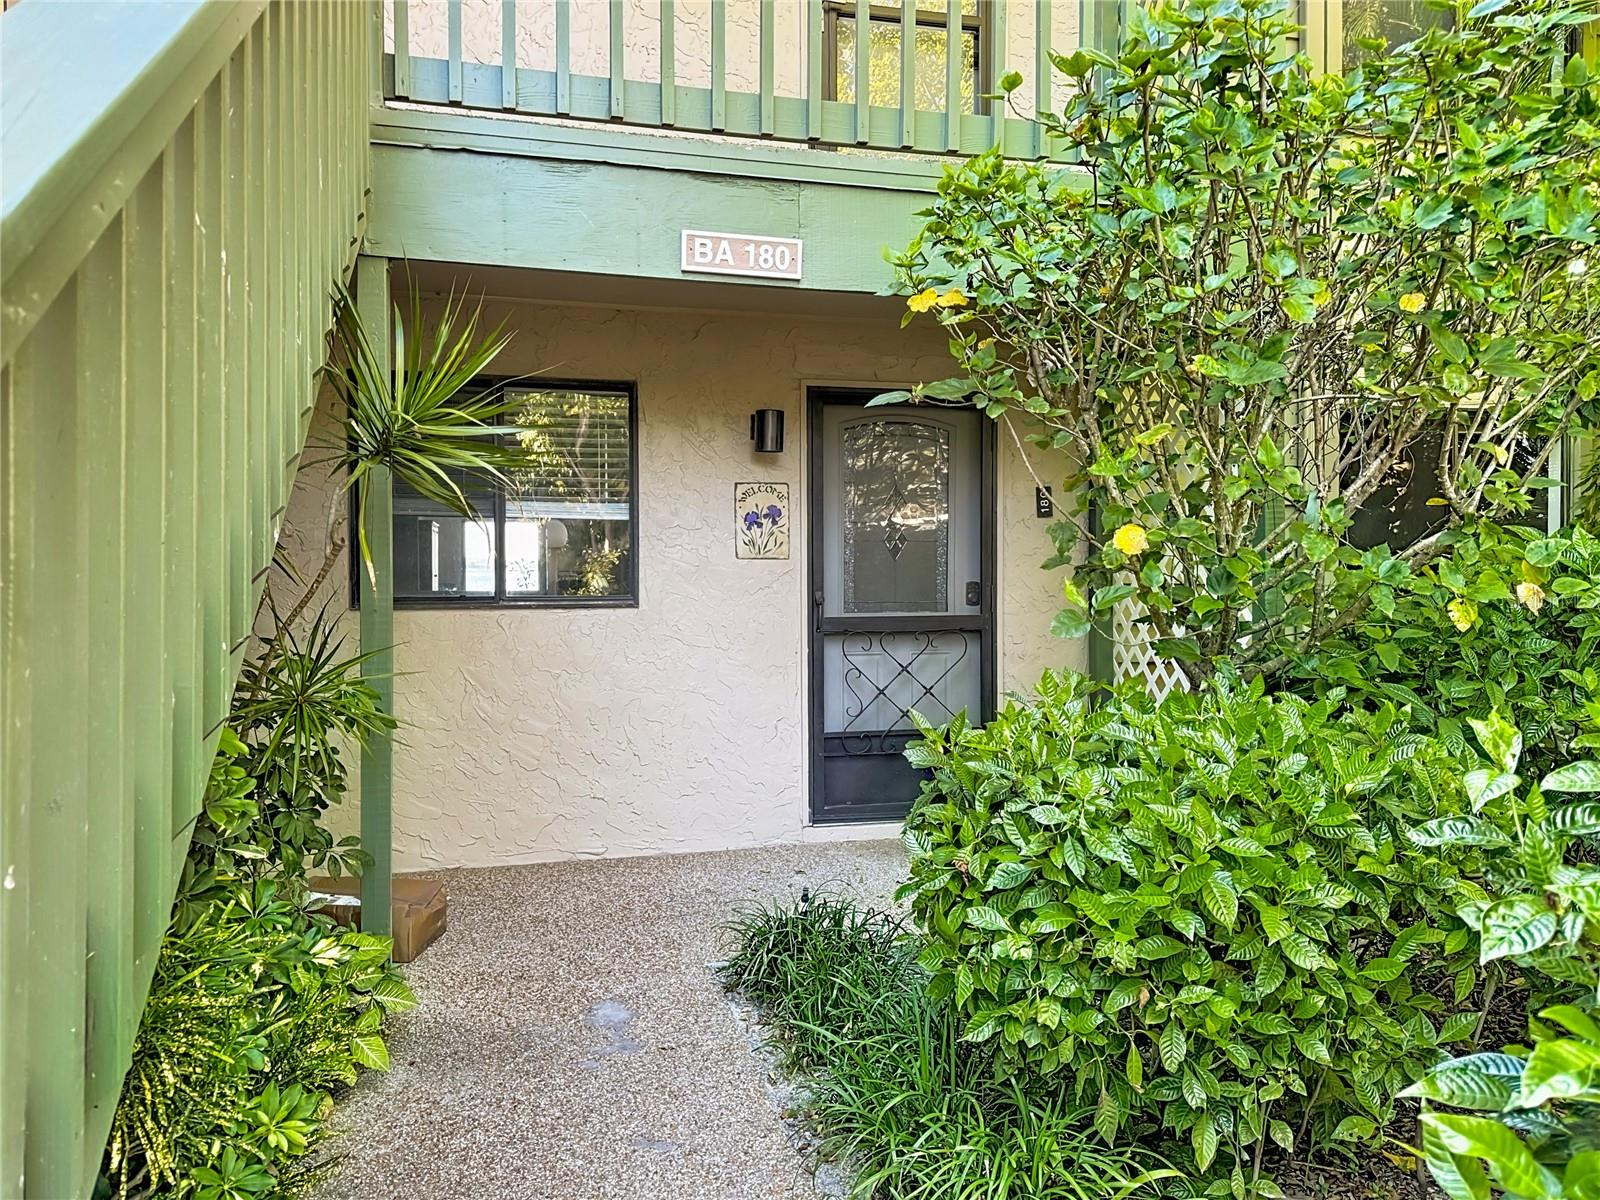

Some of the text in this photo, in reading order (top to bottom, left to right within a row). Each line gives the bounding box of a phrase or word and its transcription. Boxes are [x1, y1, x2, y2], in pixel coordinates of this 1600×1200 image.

[694, 238, 790, 270] BA 180
[738, 485, 786, 503] WELCOME
